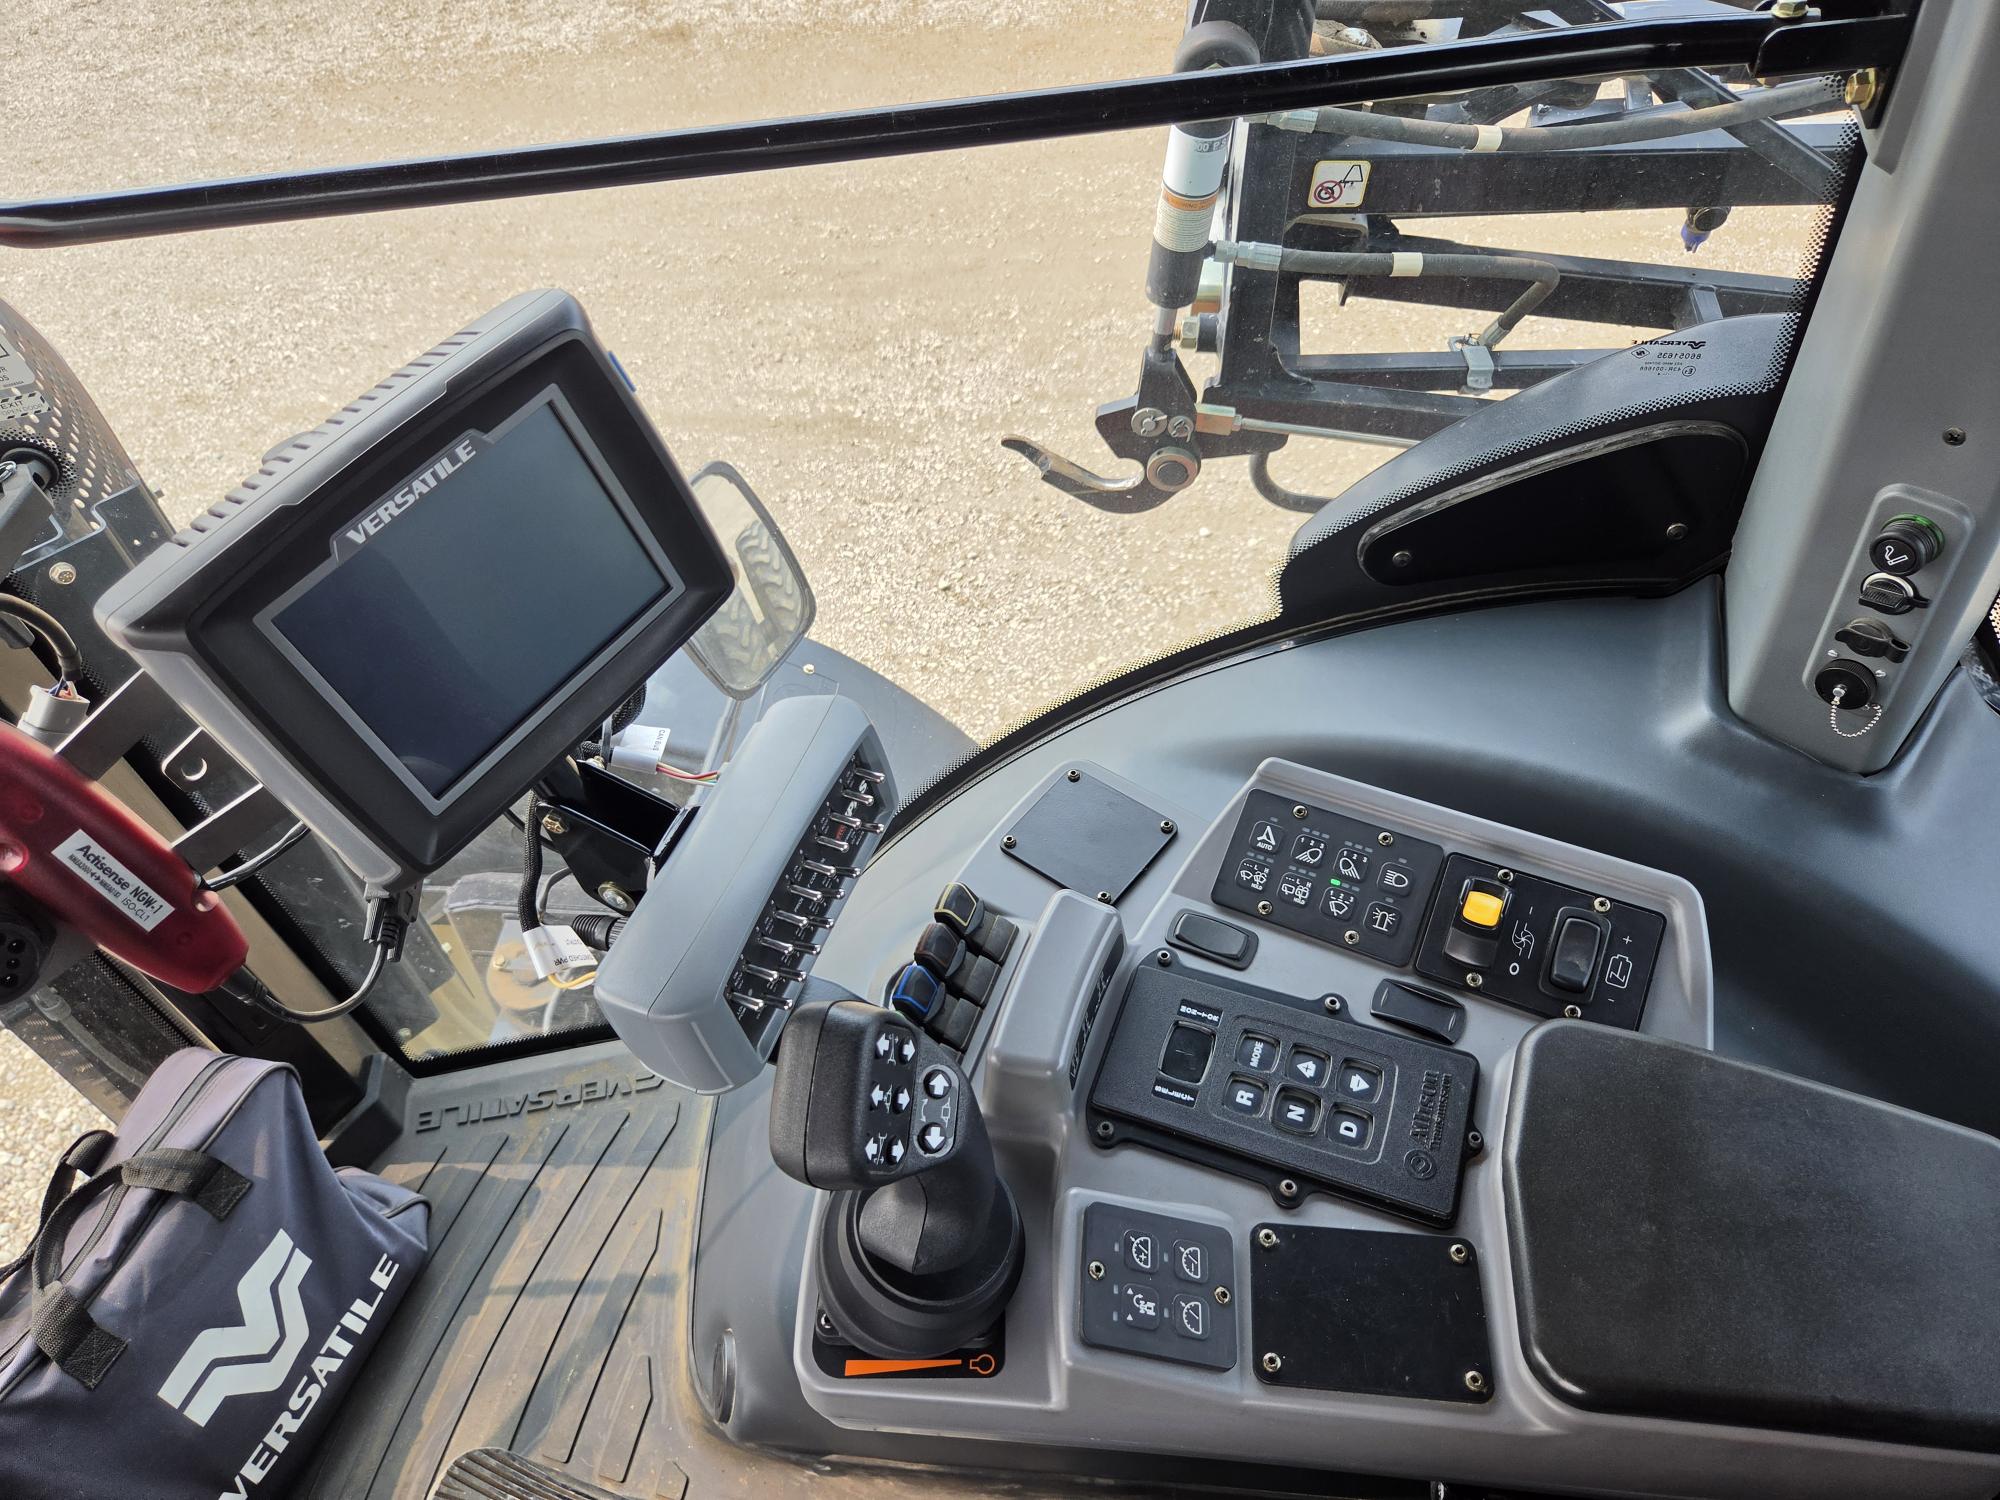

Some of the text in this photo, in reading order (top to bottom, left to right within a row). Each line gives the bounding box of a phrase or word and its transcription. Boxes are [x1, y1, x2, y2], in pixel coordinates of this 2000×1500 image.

[346, 440, 476, 544] VERSATILE
[1256, 841, 1273, 851] AUTO
[75, 844, 163, 914] Actisense NGW-1
[121, 897, 150, 922] ISO-CL1
[1180, 1005, 1220, 1022] MONITOR
[1249, 1041, 1264, 1068] MODE
[1154, 1085, 1195, 1102] SELECT
[1235, 1089, 1254, 1107] R
[415, 1078, 633, 1134] VERSATILE
[1286, 1104, 1306, 1122] N
[1409, 1069, 1440, 1149] Allison
[1339, 1120, 1358, 1139] D
